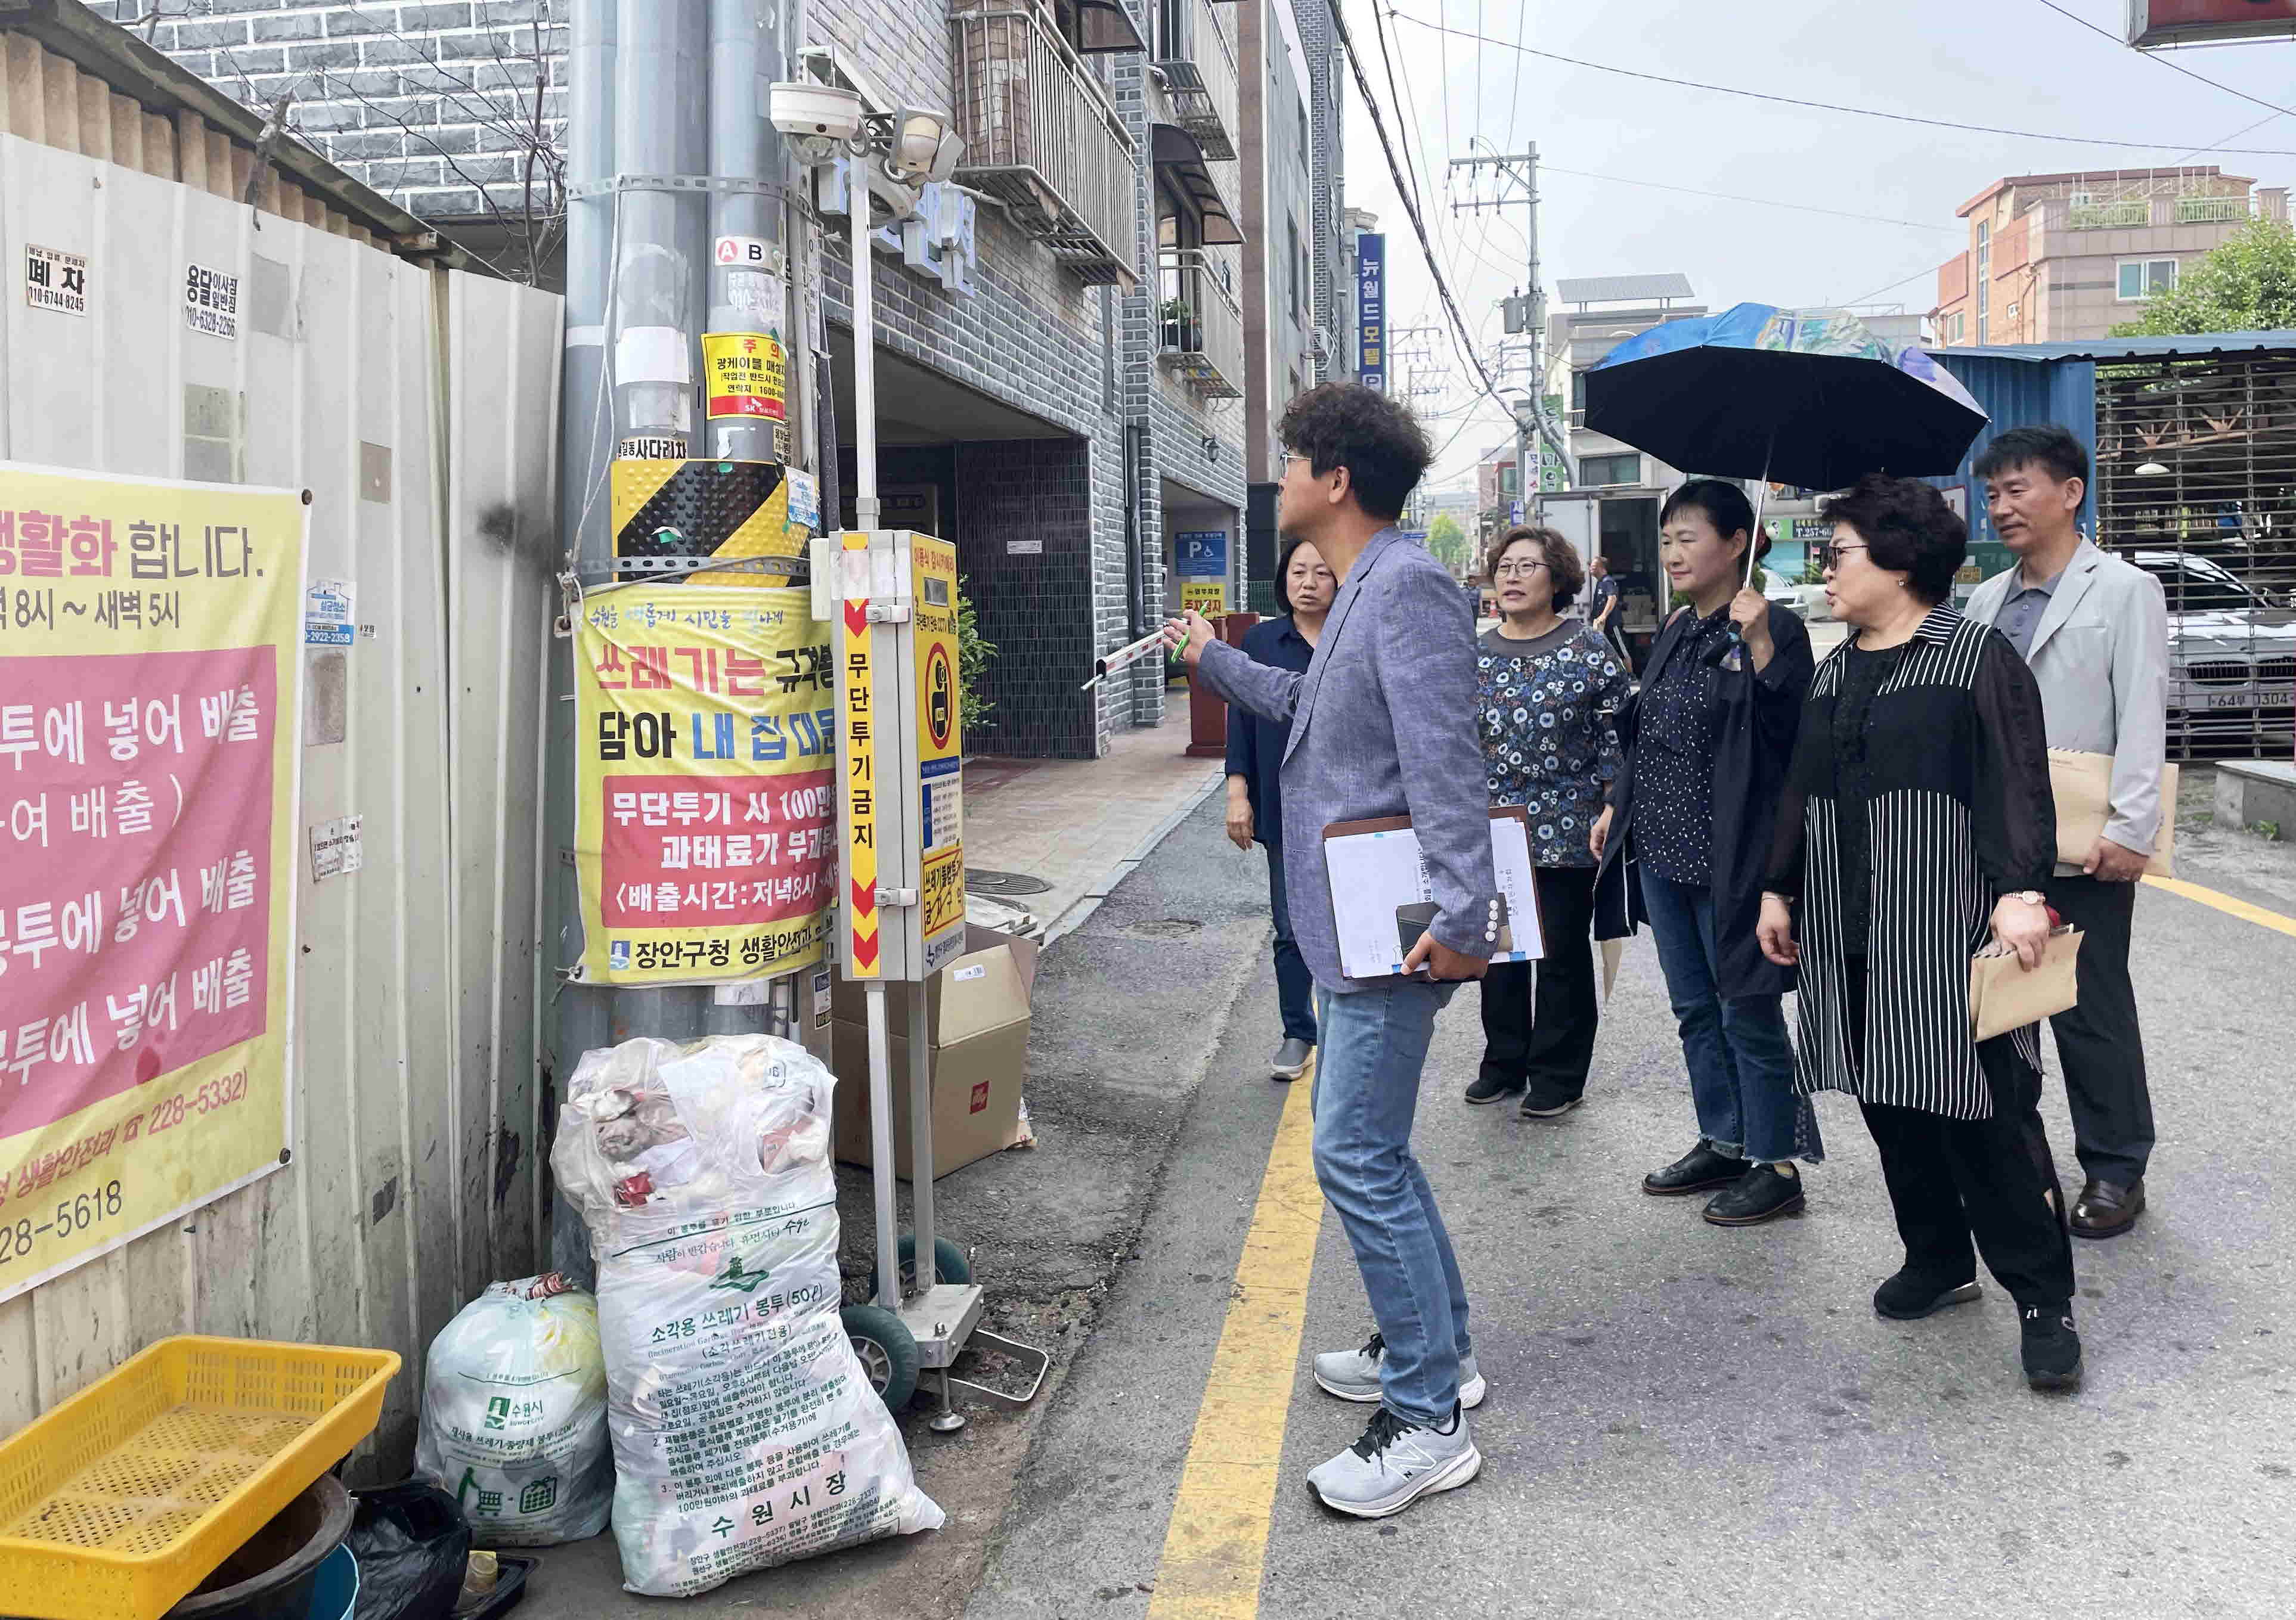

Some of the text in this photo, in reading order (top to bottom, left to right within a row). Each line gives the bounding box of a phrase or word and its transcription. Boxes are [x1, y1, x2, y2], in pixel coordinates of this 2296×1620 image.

[749, 244, 762, 260] B
[29, 257, 85, 294] 폐차
[187, 265, 212, 306] 용달
[717, 358, 762, 370] 광케이블
[750, 373, 770, 383] 반드시
[636, 439, 686, 460] 사다리차
[129, 520, 264, 579] 합니다.
[15, 588, 54, 630] 8시
[94, 591, 142, 630] 새벽
[149, 591, 179, 629] 5시
[683, 608, 732, 629] 시민을
[596, 644, 766, 696] 쓰레기는
[104, 694, 184, 761] 넣어
[200, 684, 260, 744] 배출
[600, 711, 677, 760] 담아
[692, 712, 735, 759] 내
[848, 653, 872, 848] 무단투기금지
[0, 792, 48, 848] 여
[70, 780, 154, 839] 배출
[613, 785, 836, 826] 무단투기 시 100만
[661, 833, 779, 869] 과태료가
[114, 868, 185, 943] 넣어
[200, 849, 256, 914] 배출
[636, 939, 730, 969] 장안구청
[106, 972, 178, 1051] 넣어
[193, 948, 253, 1014] 배출
[651, 1318, 695, 1344] 소각용
[701, 1305, 748, 1331] 쓰레기
[476, 1435, 503, 1448] 쓰레기
[786, 1438, 819, 1455] 사용하여
